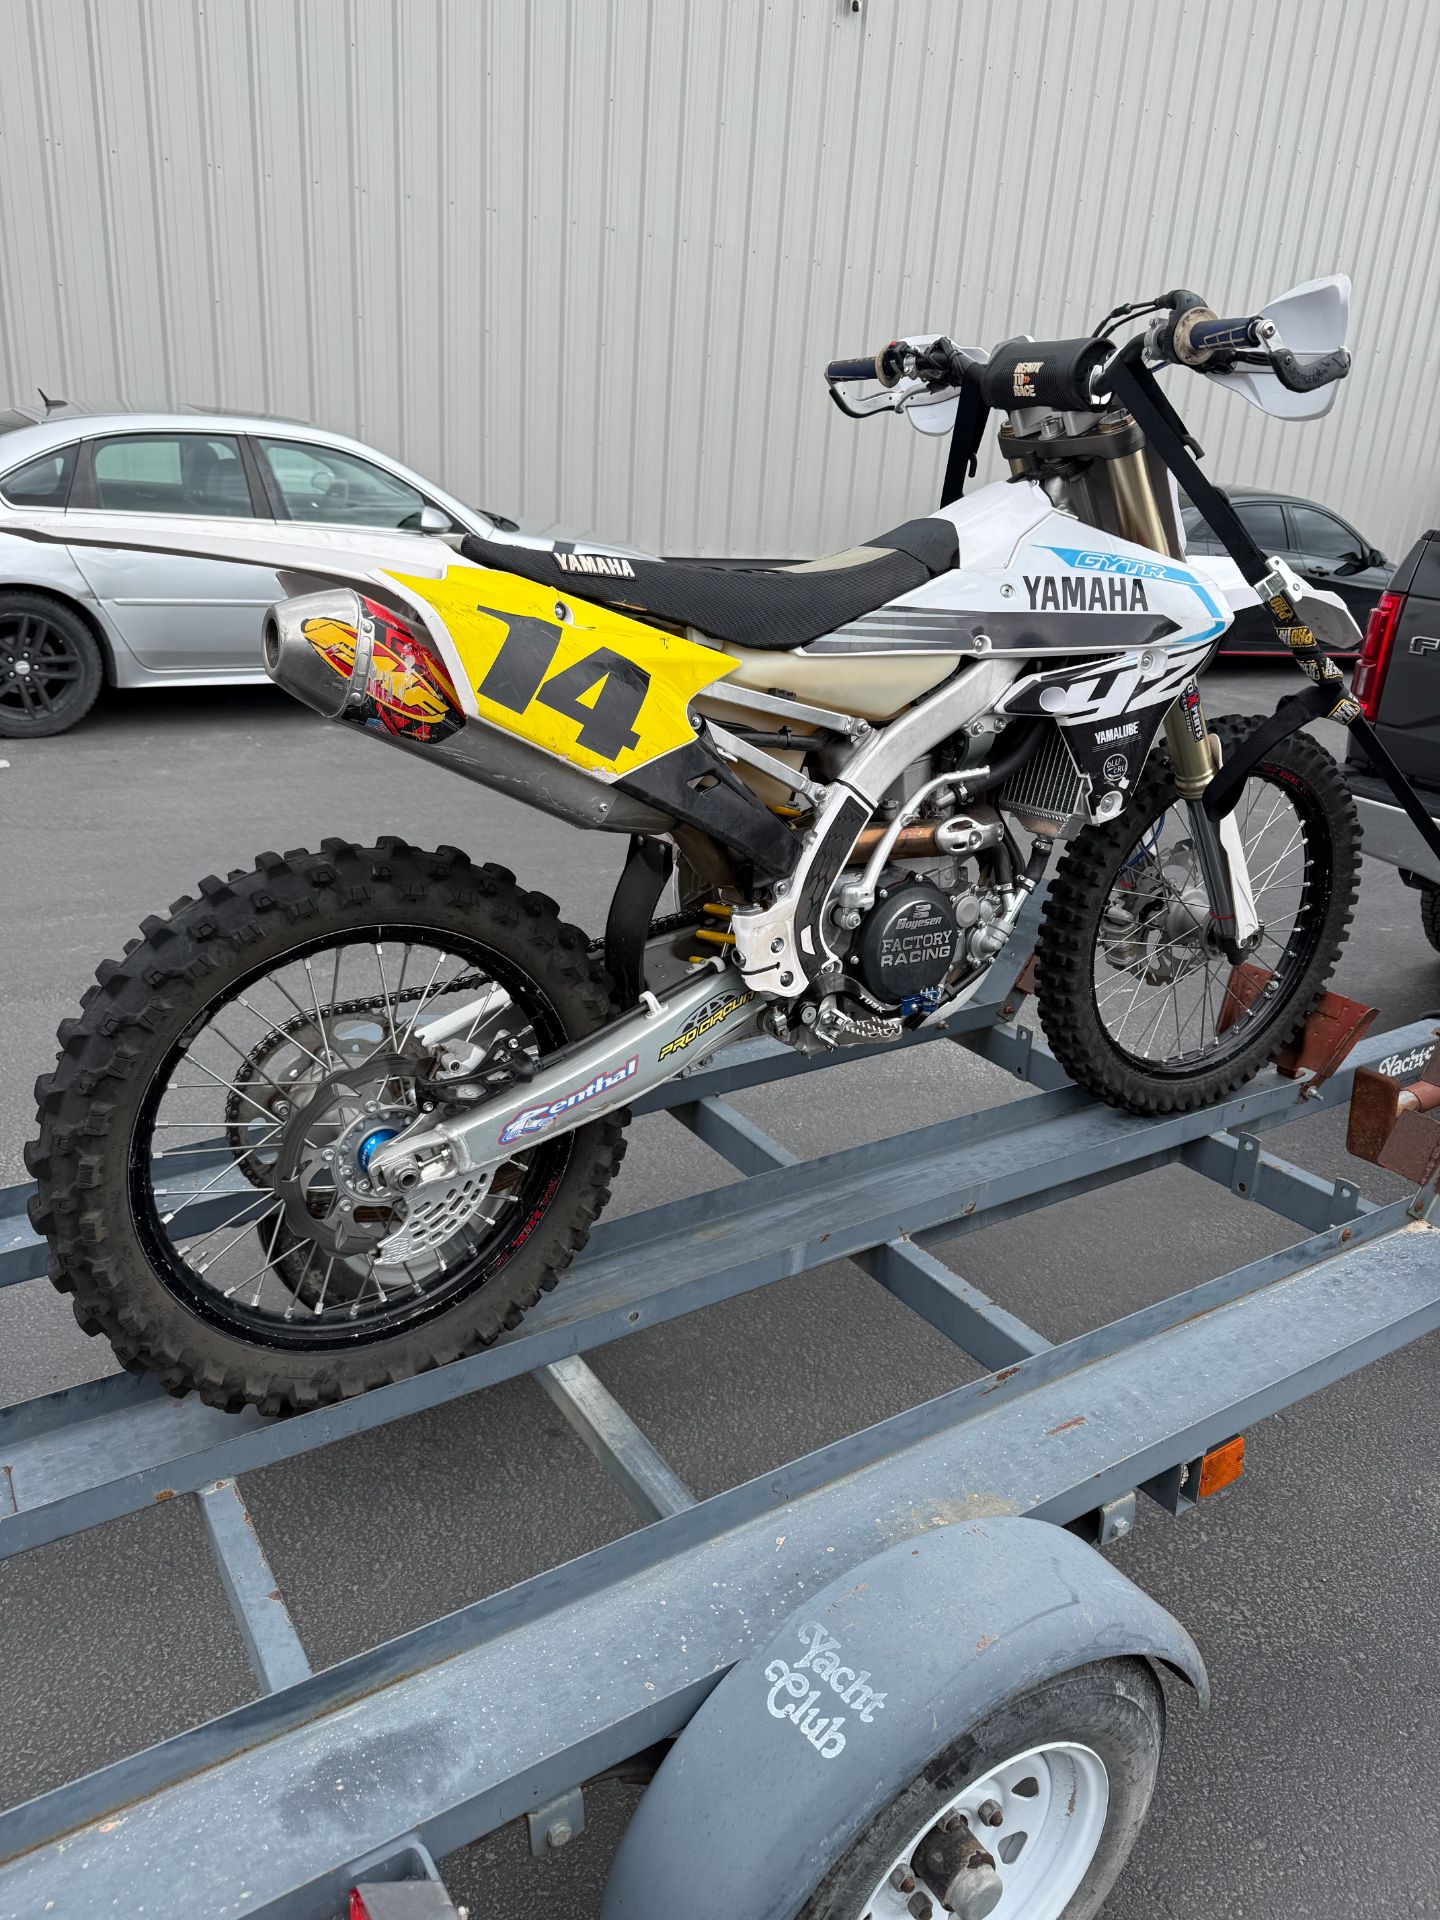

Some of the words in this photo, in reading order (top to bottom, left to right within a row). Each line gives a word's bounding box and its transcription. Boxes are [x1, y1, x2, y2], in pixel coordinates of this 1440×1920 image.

[1013, 373, 1025, 386] TO
[1013, 384, 1037, 397] RACE
[553, 552, 636, 578] YAMAHA
[1075, 551, 1167, 578] GYTR
[1022, 575, 1149, 612] YAMAHA
[477, 605, 651, 762] 14
[1094, 721, 1140, 745] YAMALUBE
[895, 916, 943, 930] Boyesen
[882, 930, 953, 954] FACTORY
[880, 945, 951, 968] RACING
[859, 993, 887, 1014] TUSK
[658, 1027, 698, 1062] PRO
[793, 1620, 889, 1723] Yacht
[766, 1659, 847, 1759] Club
